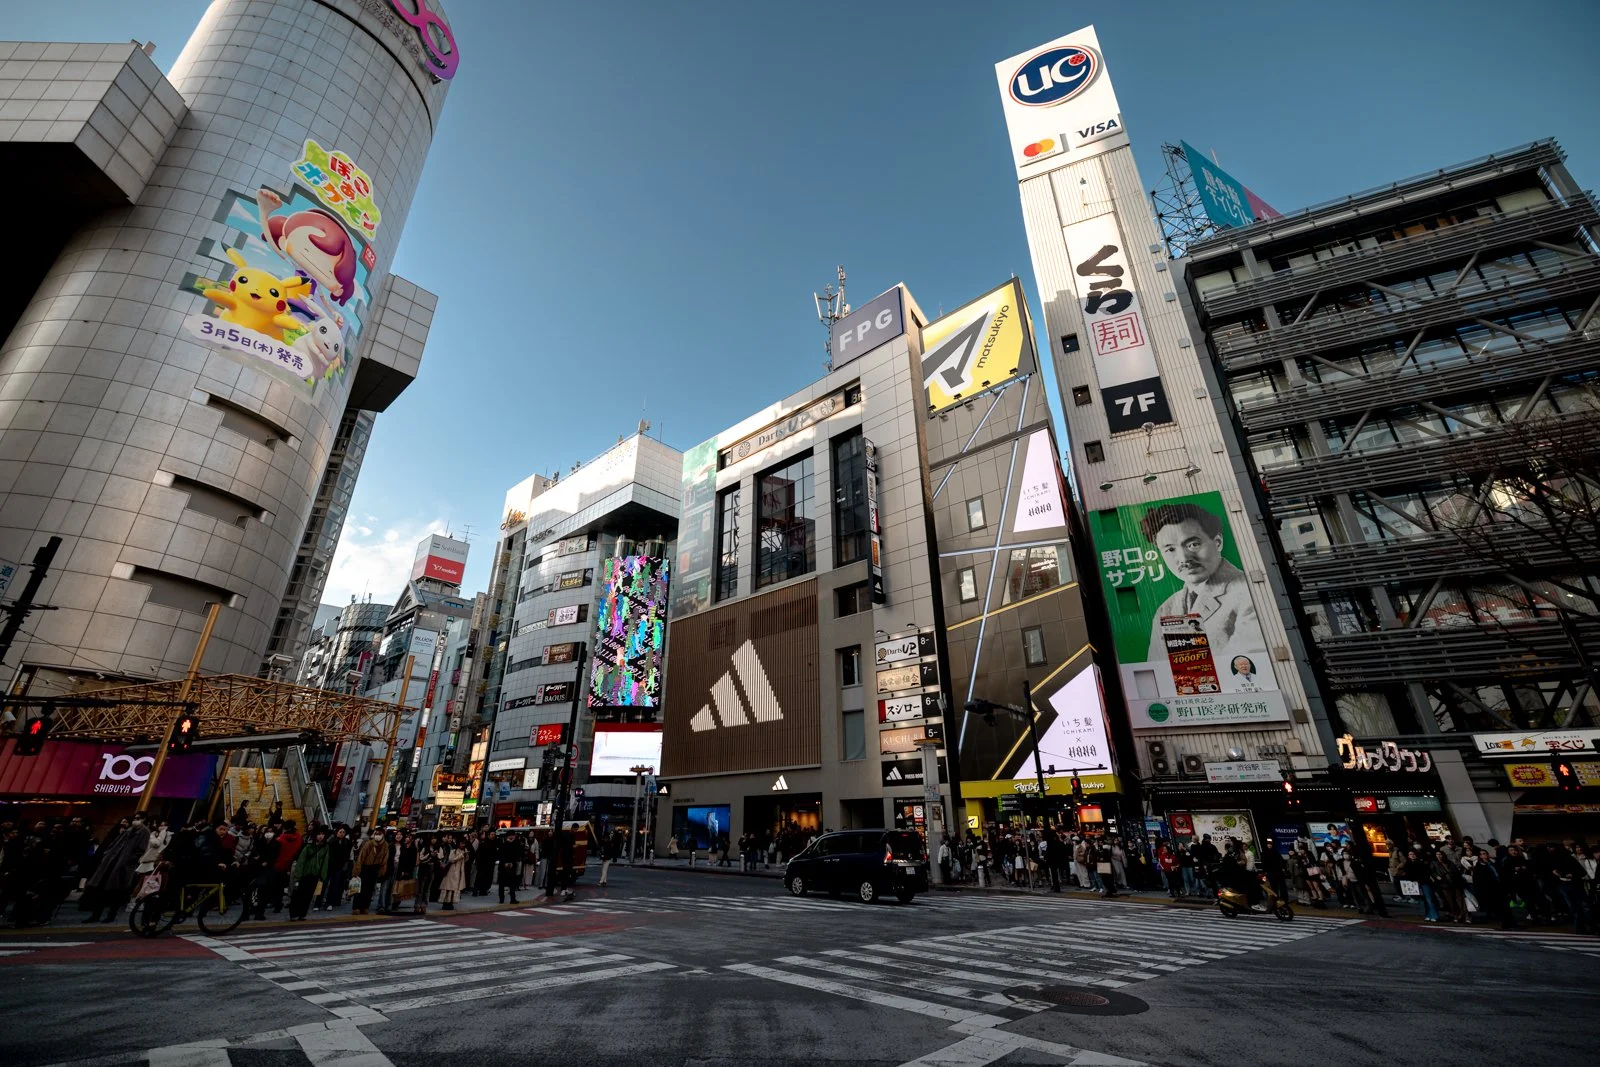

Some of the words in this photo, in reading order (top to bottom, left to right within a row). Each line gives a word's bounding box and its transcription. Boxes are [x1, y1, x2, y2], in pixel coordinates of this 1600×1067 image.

[1017, 52, 1087, 97] UC
[1079, 119, 1118, 139] VISA
[297, 162, 375, 231] ポケモン
[839, 308, 893, 352] FPG
[976, 305, 1010, 369] matsukiyo
[1096, 316, 1139, 351] 寿司
[200, 321, 304, 370] 3月5日(木)発売
[1114, 392, 1156, 417] 7F
[758, 428, 784, 447] Darts
[785, 411, 811, 433] UP
[1101, 547, 1159, 569] 野口の
[1106, 564, 1165, 587] サプリ
[887, 647, 902, 656] Darts
[902, 642, 917, 655] UP
[1173, 652, 1208, 664] 4000FU
[887, 703, 920, 715] スシロー
[1176, 701, 1268, 718] 野口医学研究所
[1061, 717, 1093, 728] いち髪
[99, 753, 155, 794] 109
[94, 783, 131, 793] SHIBUYA
